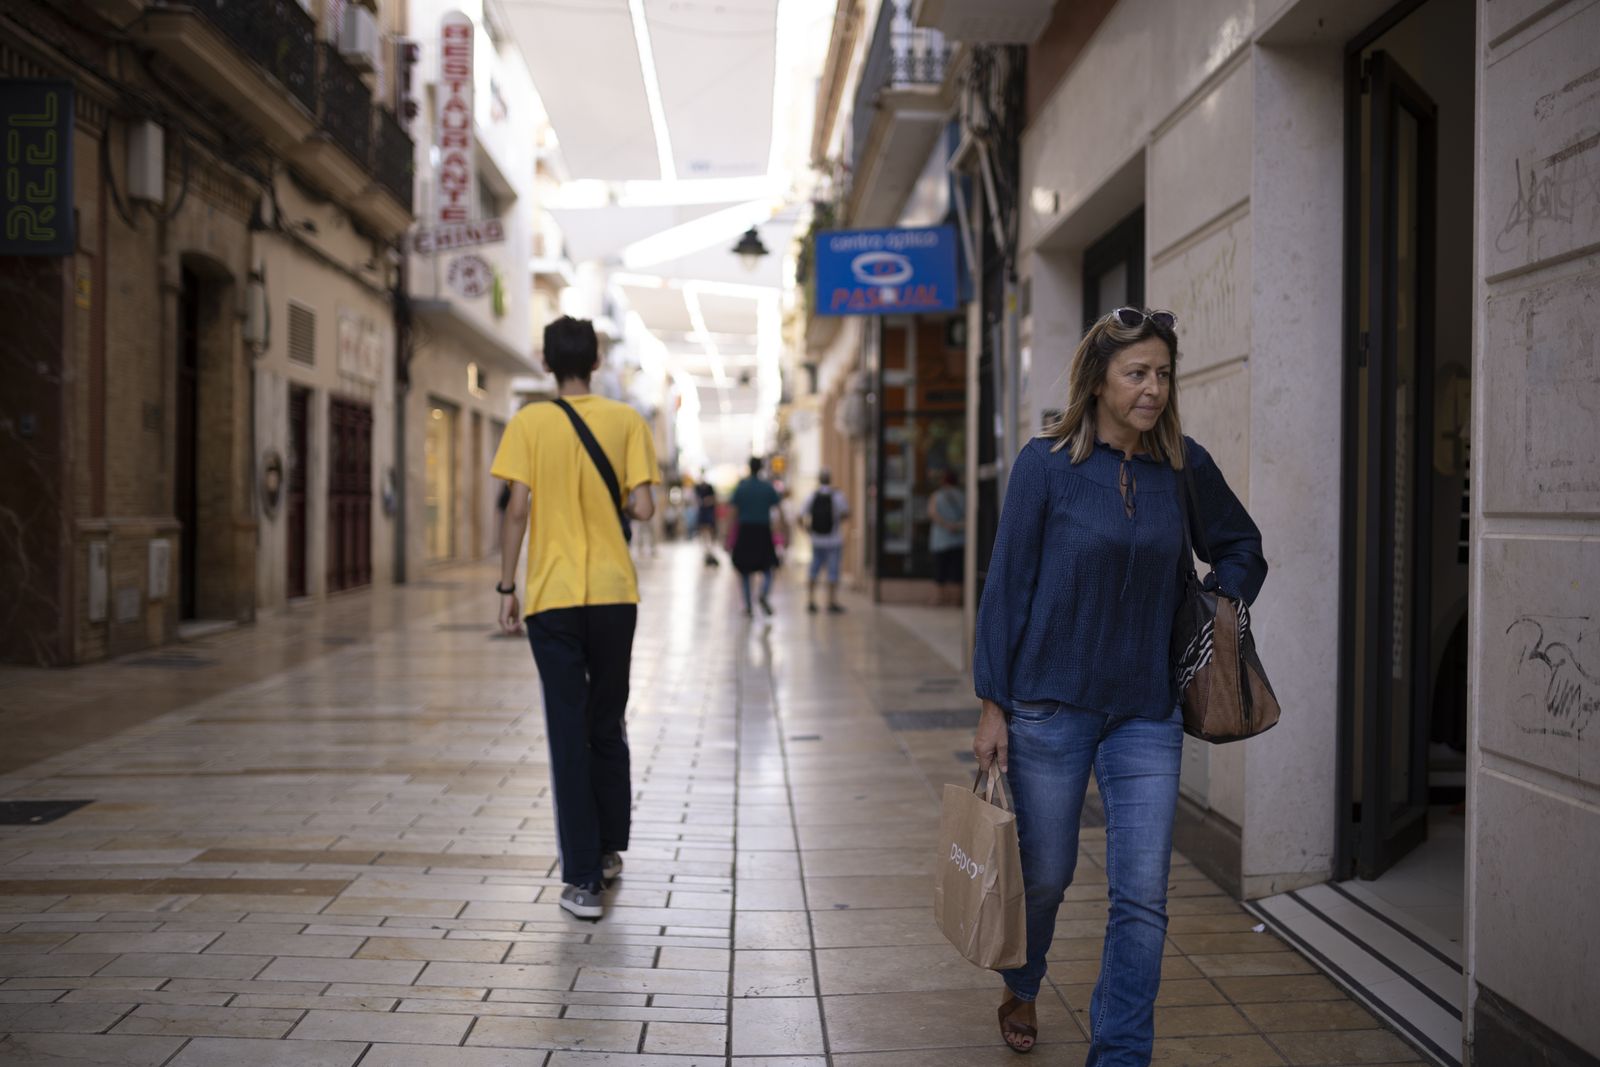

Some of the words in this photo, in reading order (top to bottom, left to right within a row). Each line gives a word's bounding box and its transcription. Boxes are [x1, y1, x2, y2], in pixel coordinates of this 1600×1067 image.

[7, 91, 57, 241] REEL
[442, 23, 470, 221] RESTAURANTE
[831, 234, 884, 252] centro
